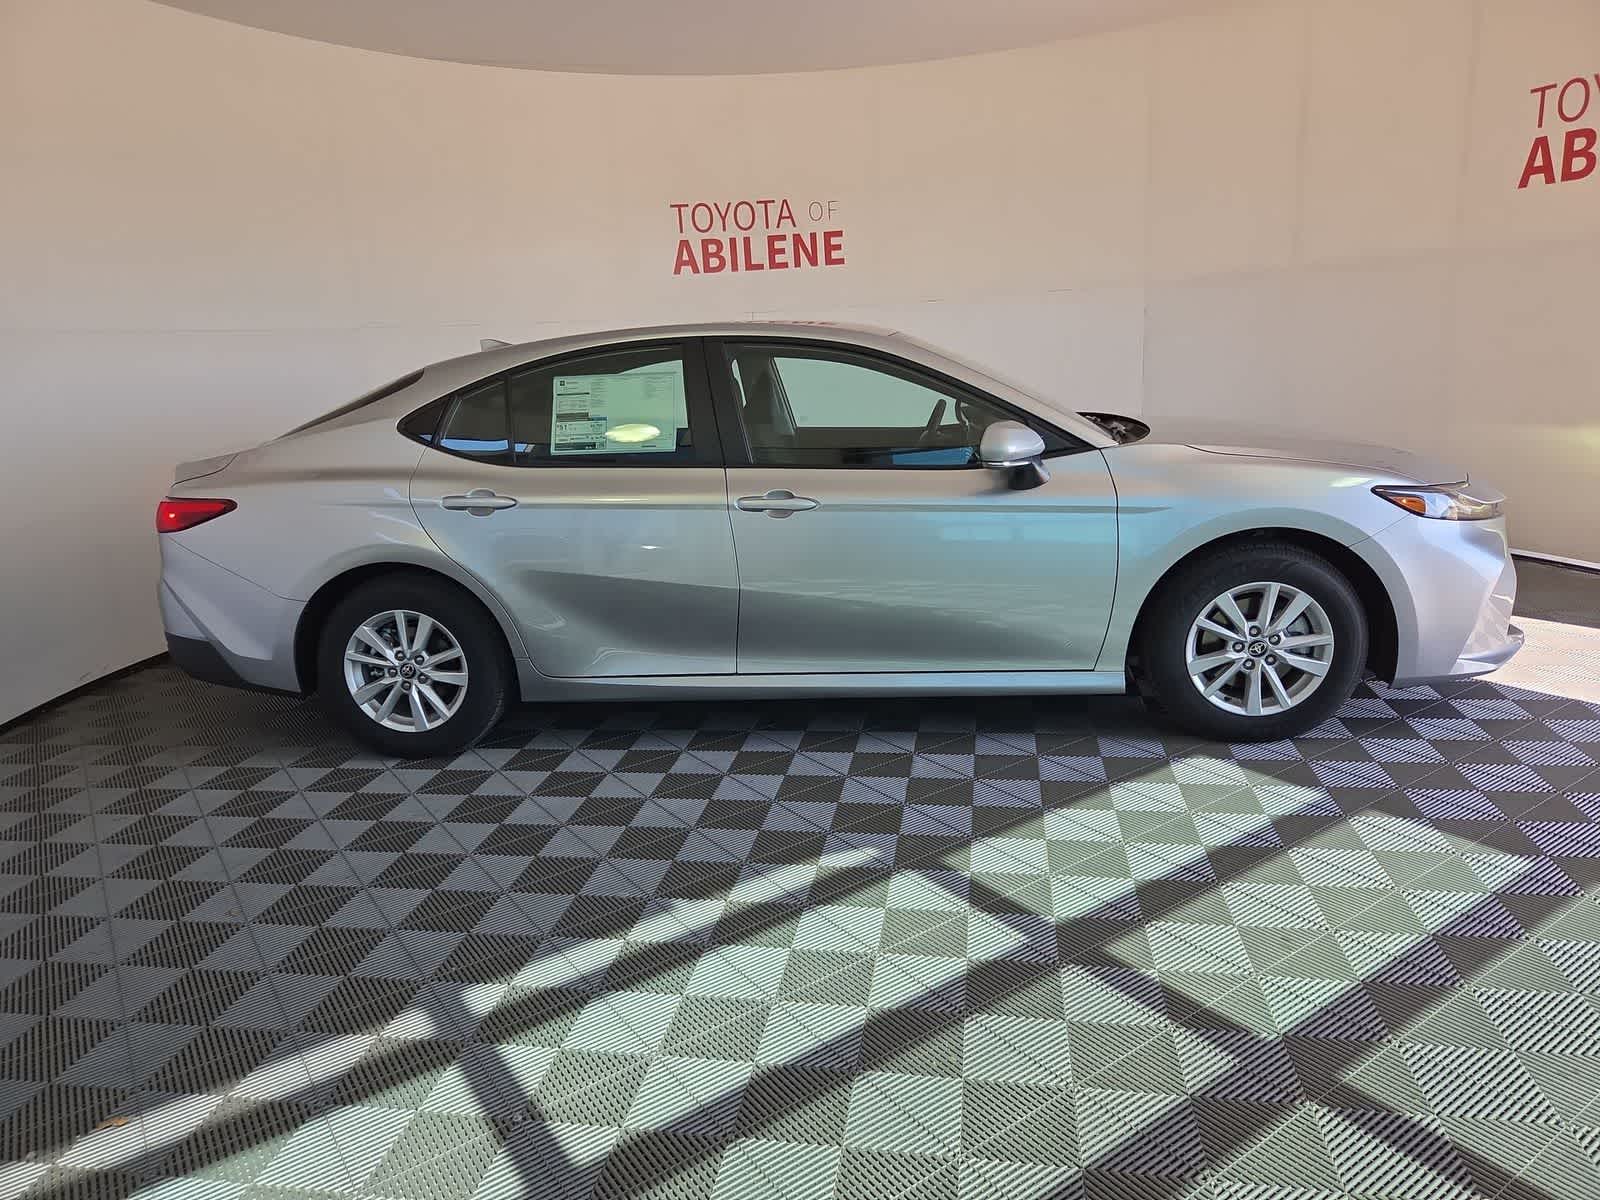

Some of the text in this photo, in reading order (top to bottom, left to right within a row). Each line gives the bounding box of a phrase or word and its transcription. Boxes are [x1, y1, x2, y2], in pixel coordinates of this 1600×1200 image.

[1530, 74, 1600, 128] TO
[670, 199, 840, 233] TOYOTA OF
[673, 230, 845, 275] ABILENE
